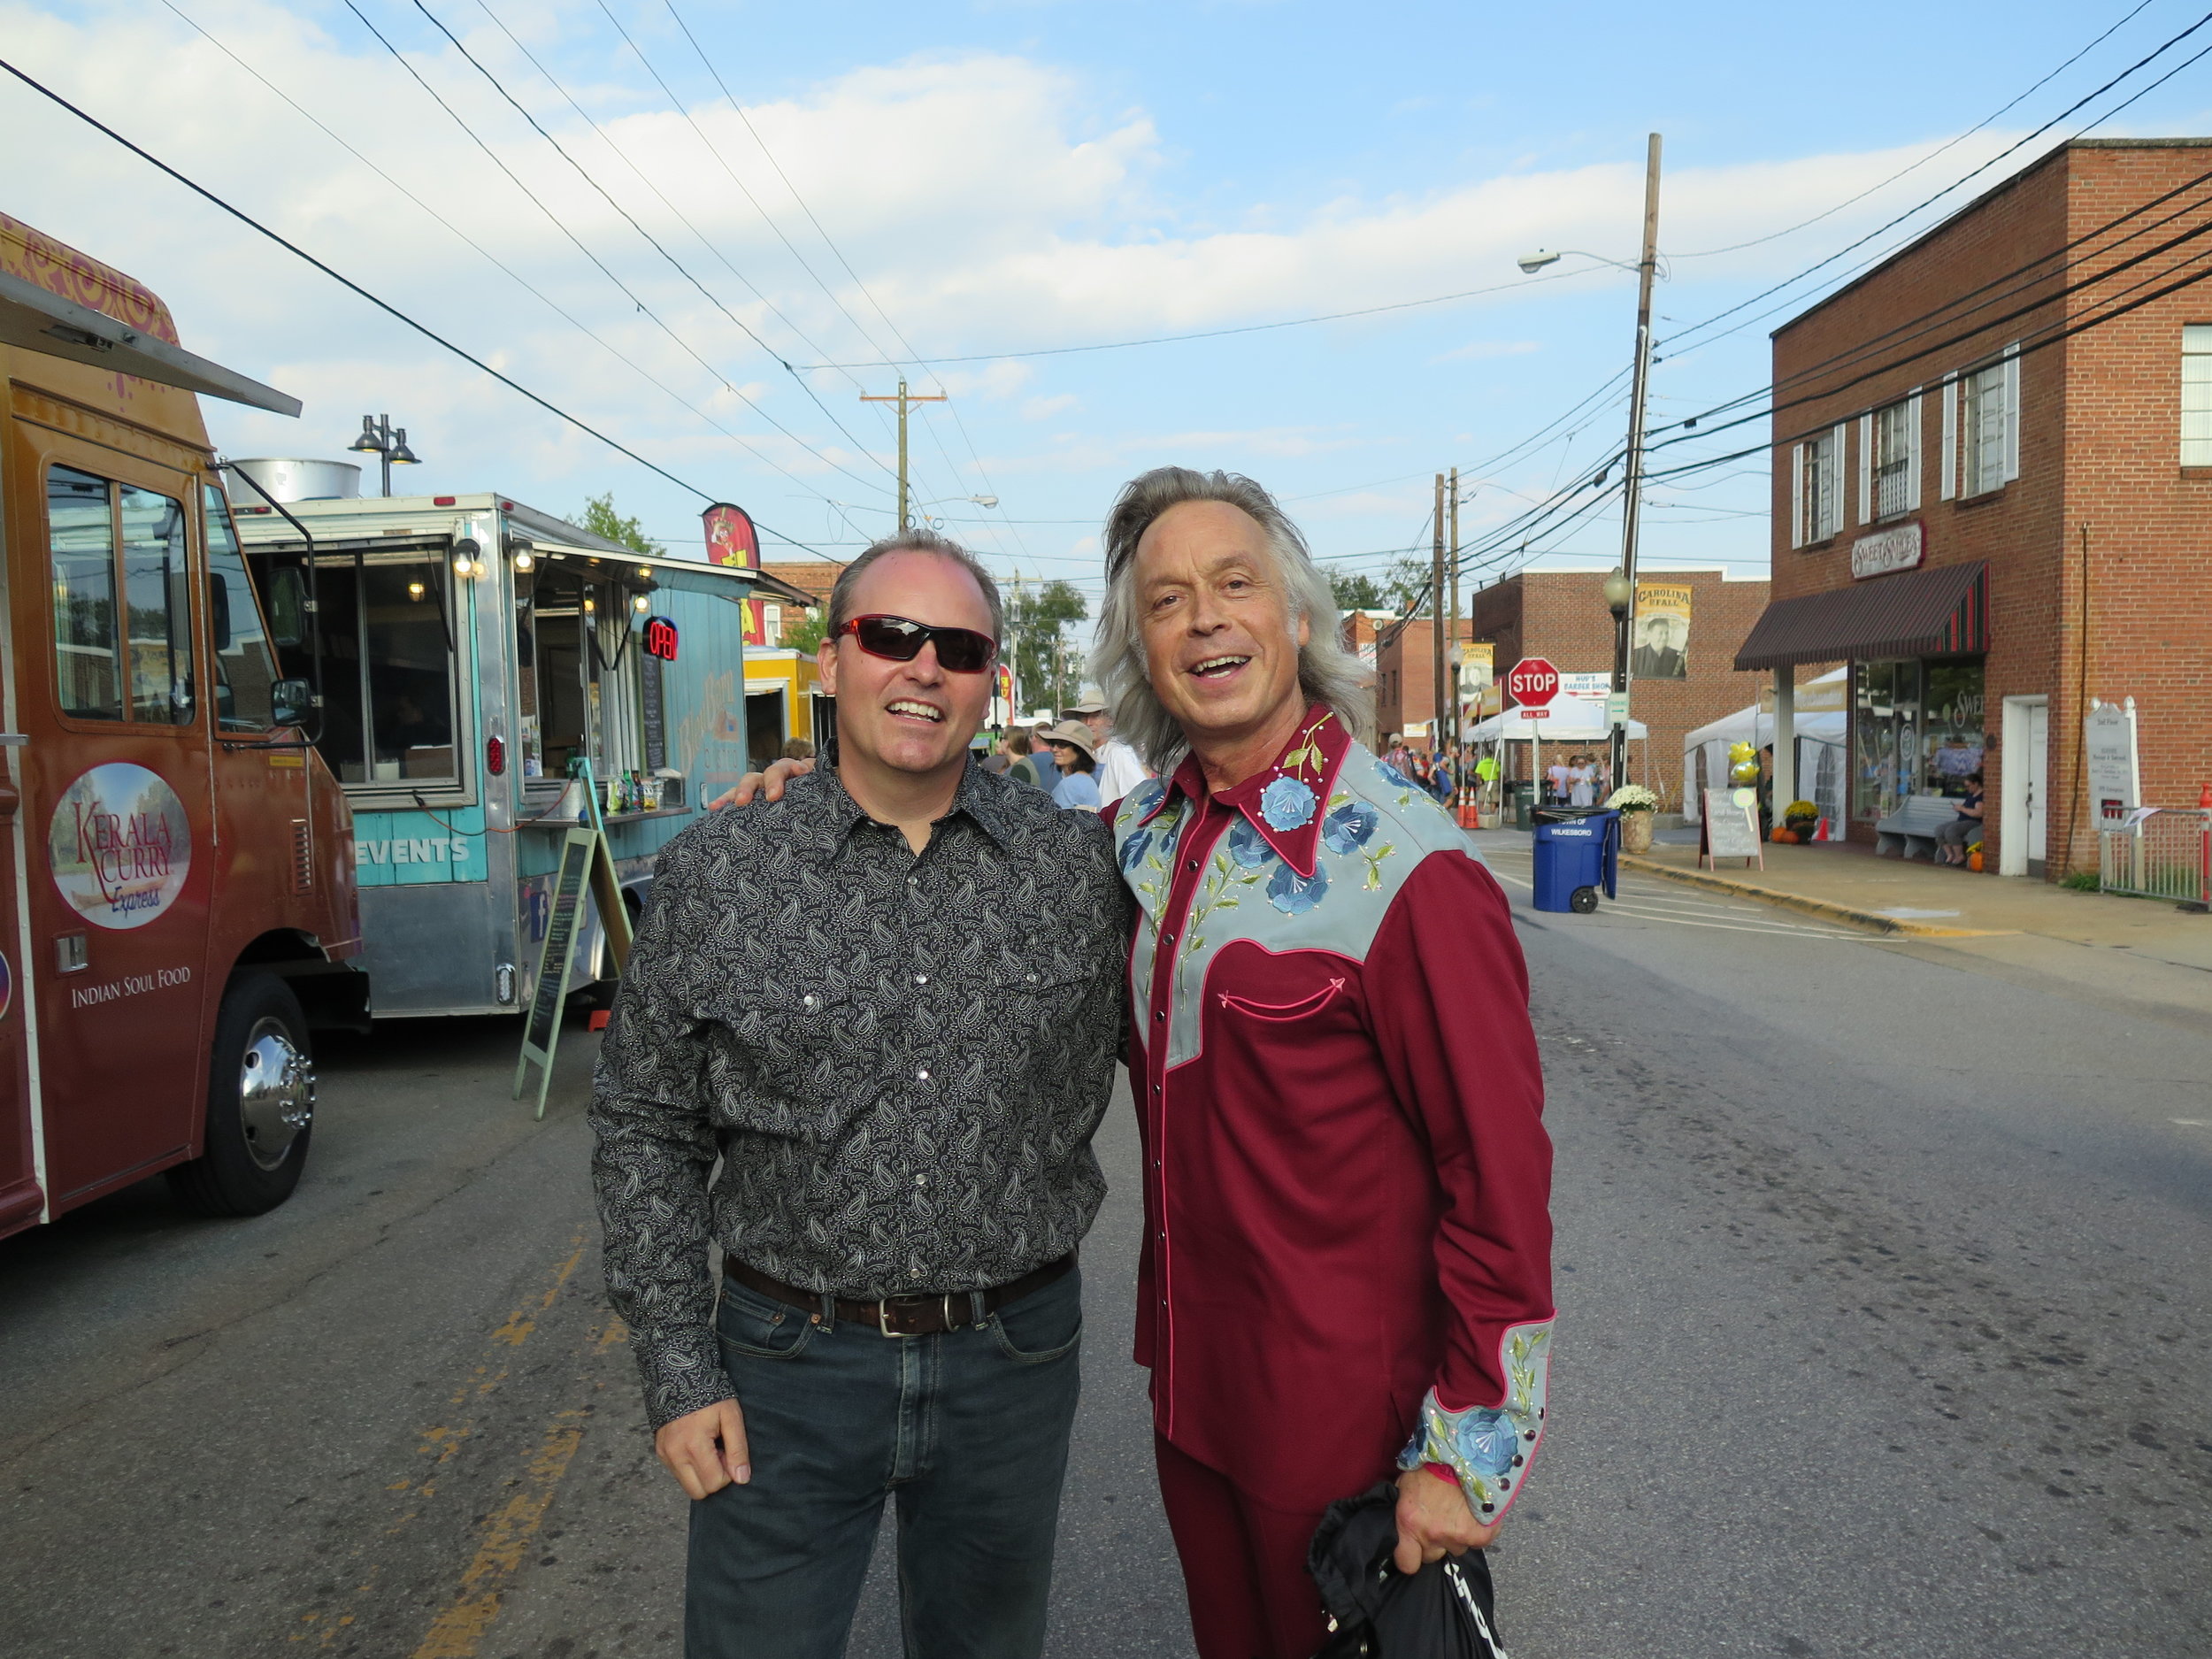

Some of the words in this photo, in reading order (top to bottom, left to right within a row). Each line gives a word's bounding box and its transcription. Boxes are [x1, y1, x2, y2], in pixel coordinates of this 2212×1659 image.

[1638, 588, 1692, 605] CAROLINA
[1655, 598, 1679, 607] FALL
[649, 621, 679, 661] OPEN
[1513, 673, 1556, 693] STOP
[73, 801, 173, 890] KERALA
[1550, 828, 1593, 837] WILKESBORO
[101, 846, 171, 883] CURRY
[354, 837, 469, 865] EVENTS
[111, 885, 162, 918] Express
[72, 981, 121, 1009] INDIAN
[124, 974, 156, 996] SOUL
[157, 966, 191, 988] FOOD
